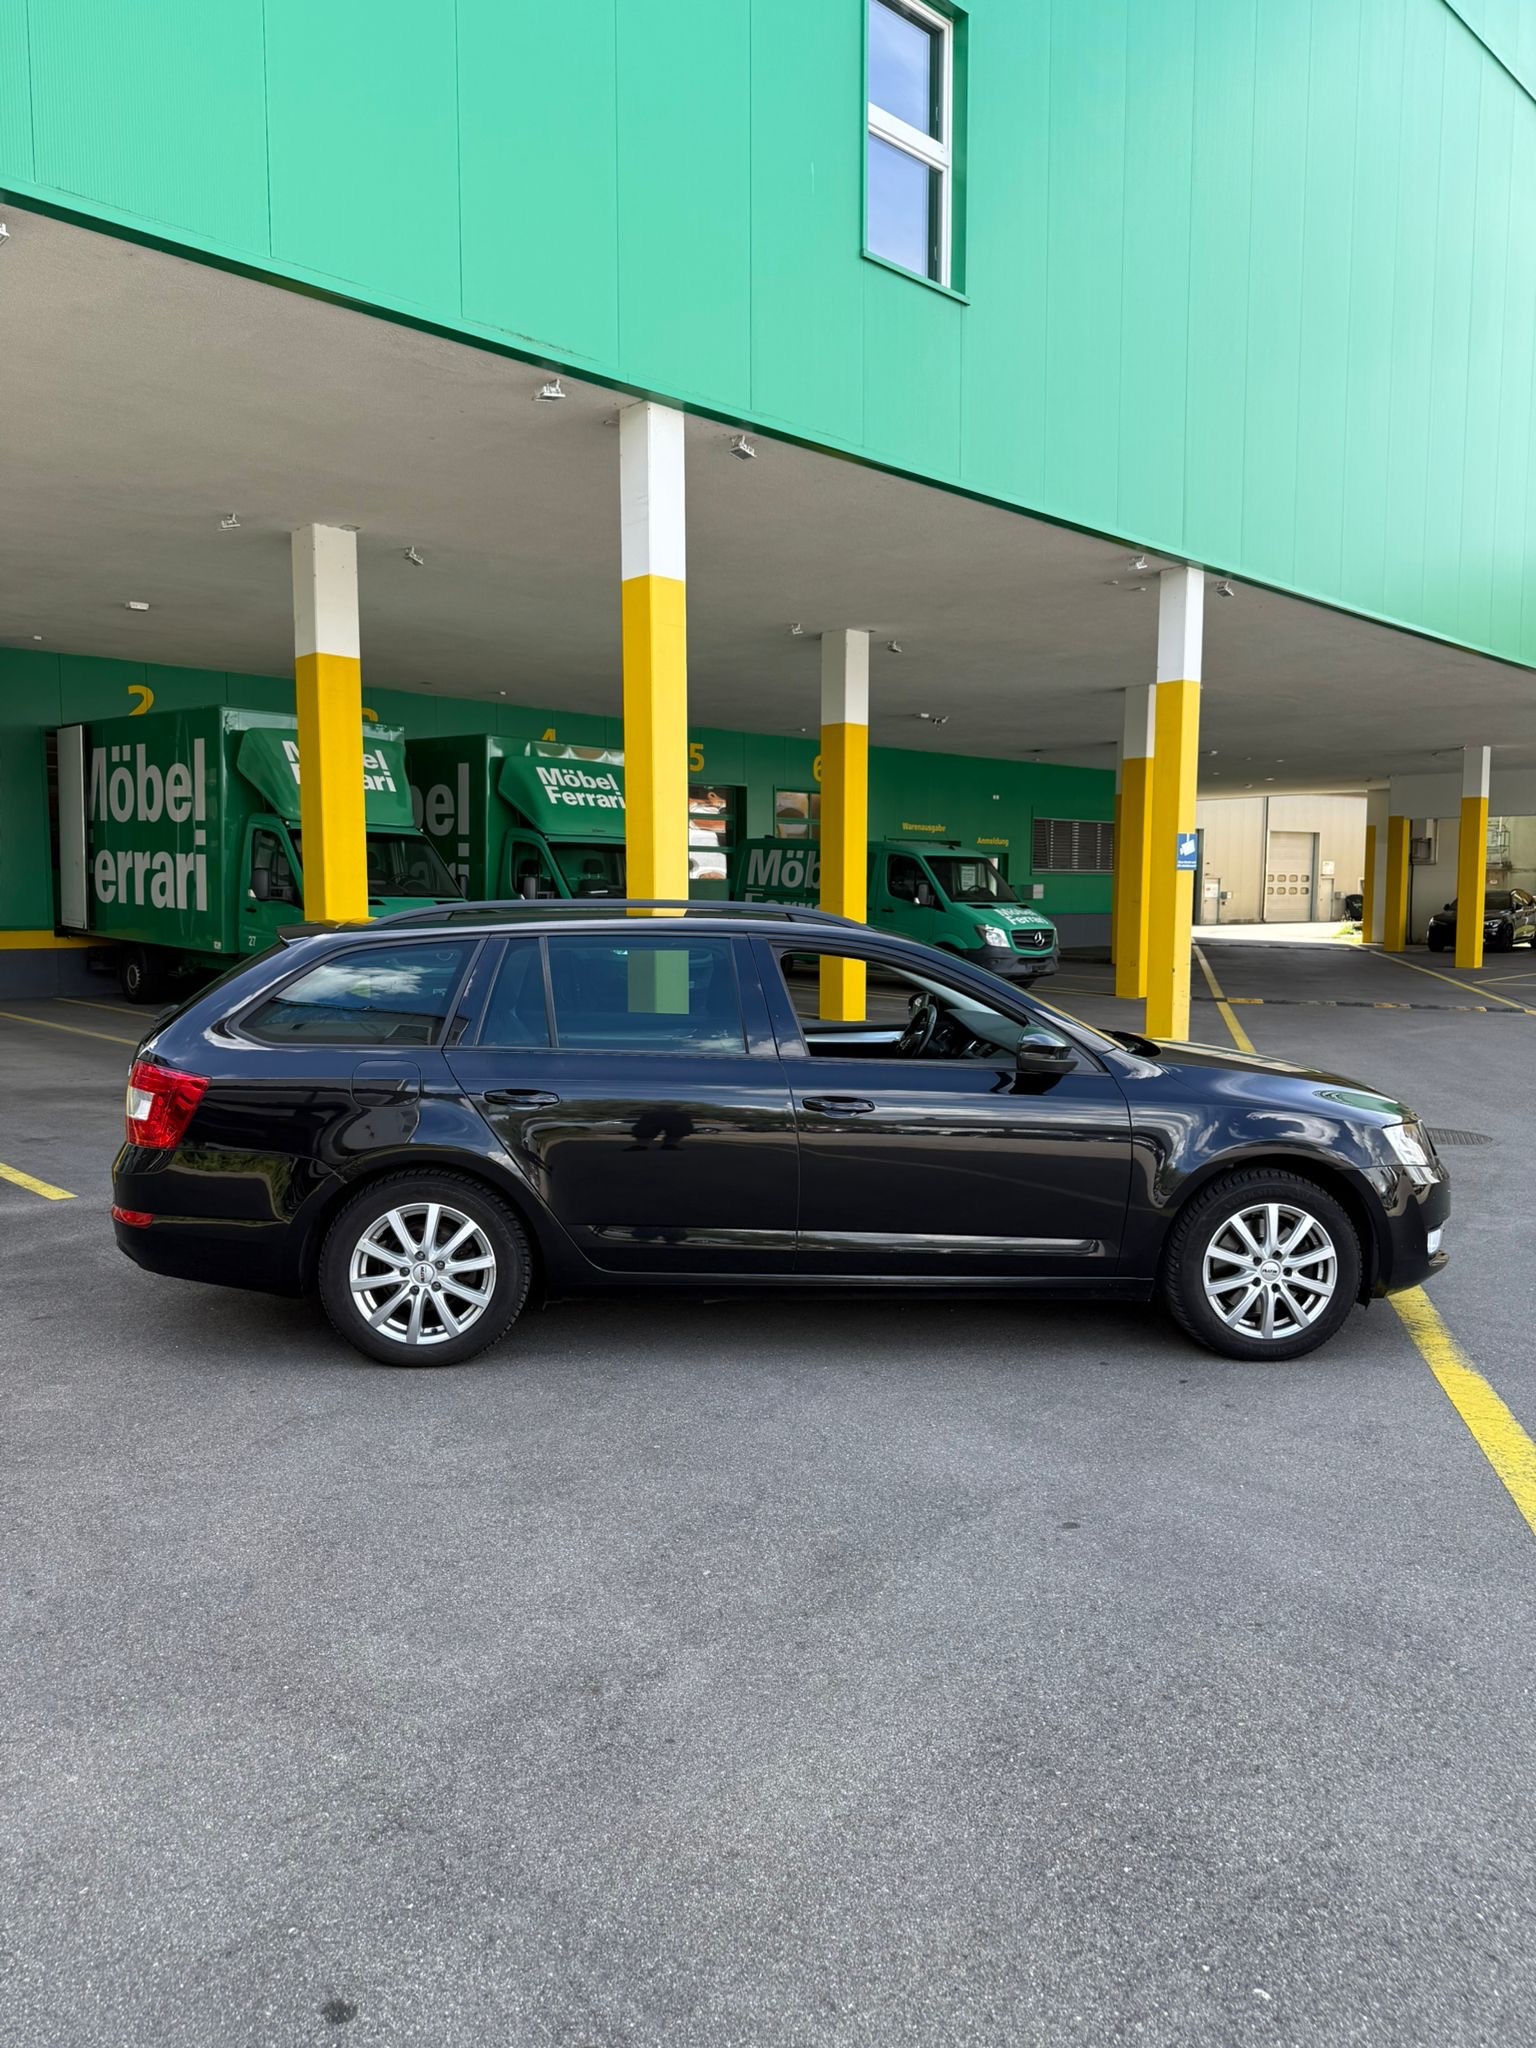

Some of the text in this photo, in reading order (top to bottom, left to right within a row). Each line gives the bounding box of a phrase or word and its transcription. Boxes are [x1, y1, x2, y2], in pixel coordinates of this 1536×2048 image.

[128, 685, 154, 716] 2
[688, 743, 705, 772] 5
[536, 766, 619, 791] Möbel
[544, 785, 627, 809] Ferrari
[902, 822, 946, 834] Warenausgabe
[976, 837, 1009, 847] Anmeldung
[89, 829, 208, 911] errari
[747, 849, 821, 888] Möb
[1005, 915, 1049, 925] Ferrari
[248, 935, 256, 947] 27
